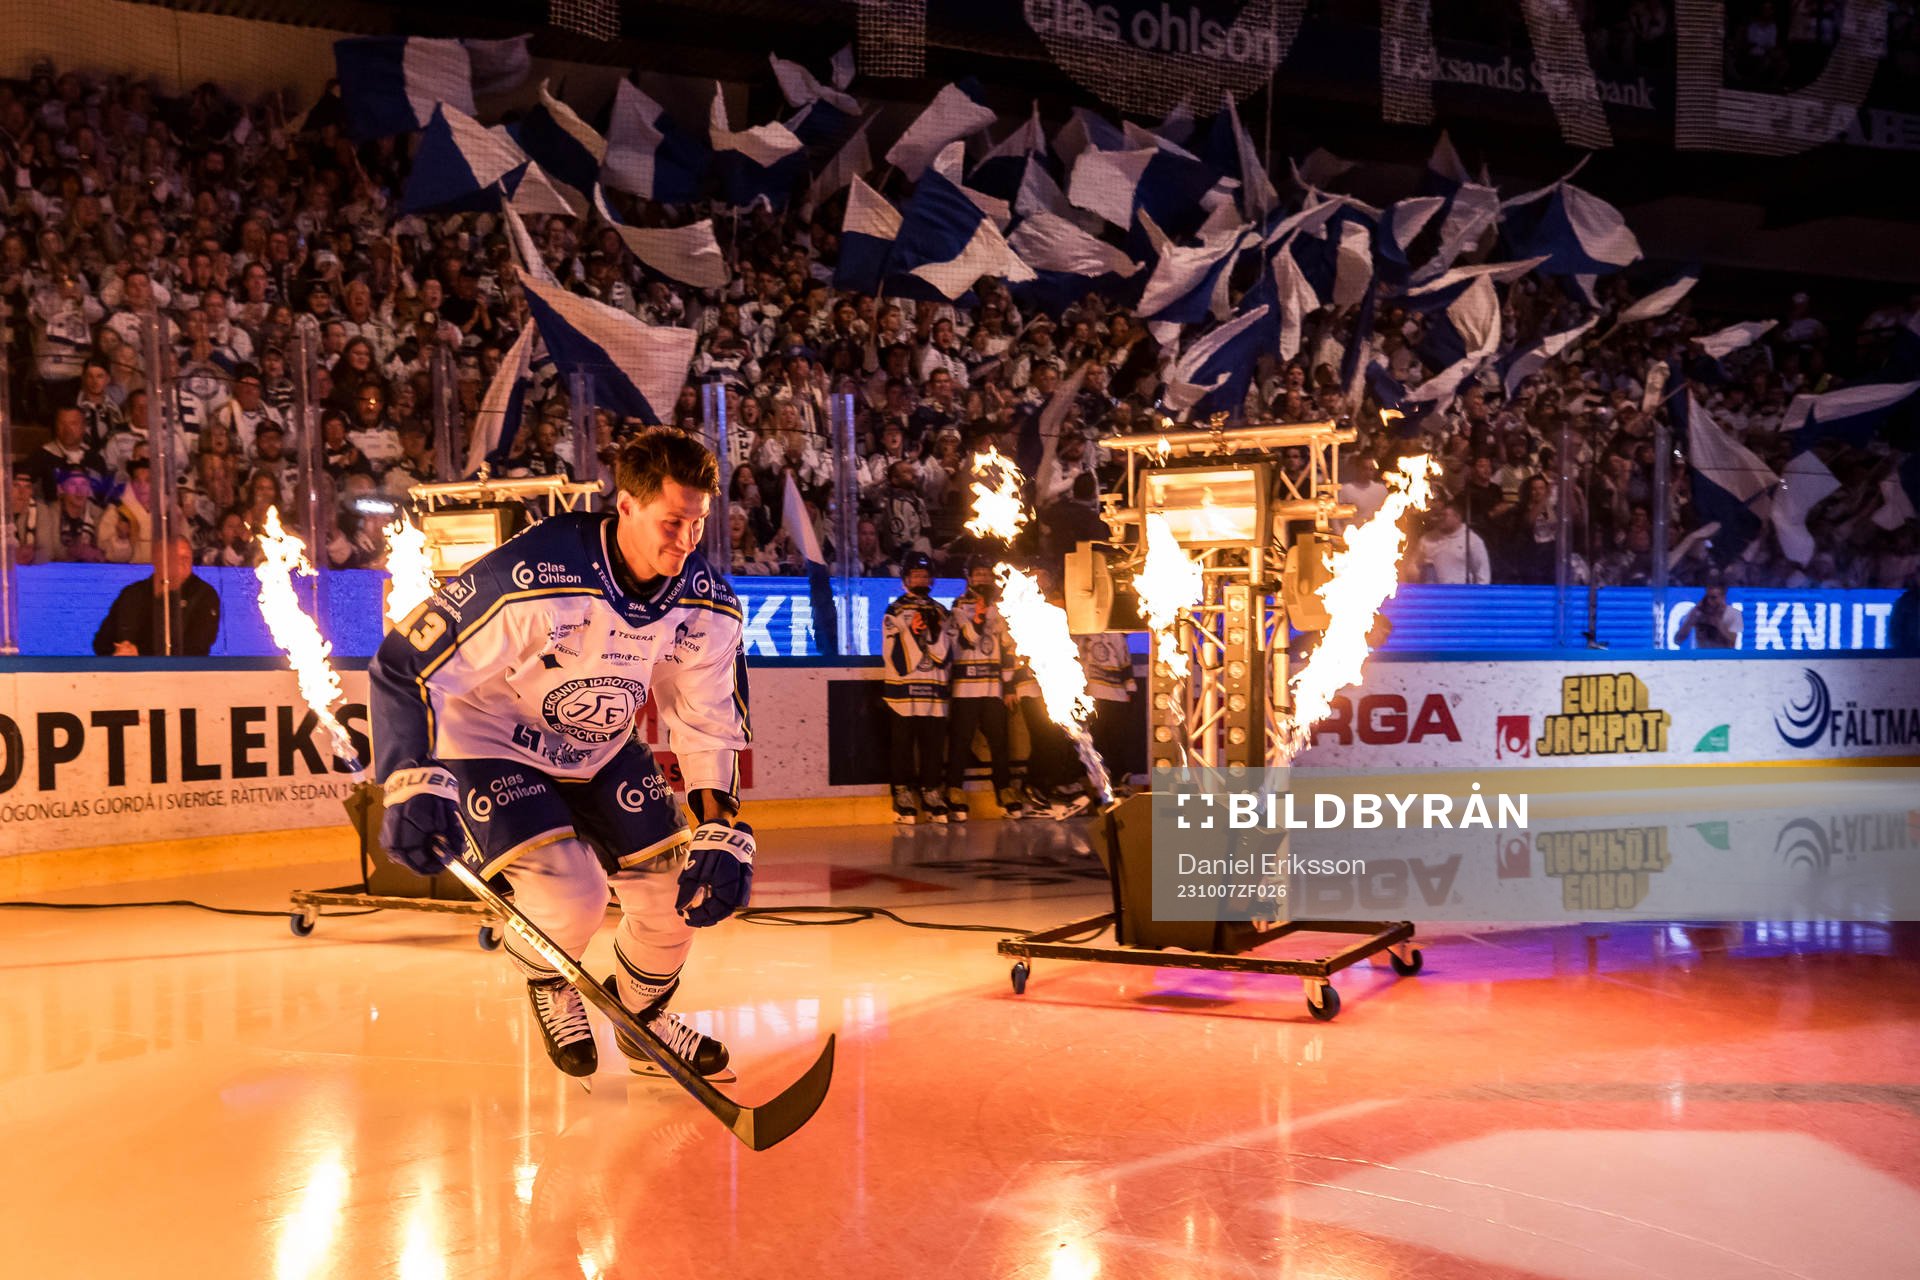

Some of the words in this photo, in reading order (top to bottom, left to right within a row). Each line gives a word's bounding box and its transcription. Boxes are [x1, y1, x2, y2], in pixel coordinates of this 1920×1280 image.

[537, 562, 566, 573] Clas
[538, 573, 582, 584] Ohlson
[712, 579, 727, 592] las
[712, 590, 737, 606] hlson
[628, 602, 647, 612] SHL
[619, 631, 655, 641] TEGERA
[544, 680, 587, 716] LEKSANDS
[1563, 672, 1644, 713] EURO
[1536, 710, 1669, 756] JACKPOT
[490, 774, 525, 793] Clas
[642, 774, 665, 789] Cla
[291, 783, 341, 801] SEDAN
[496, 784, 547, 806] Ohlson
